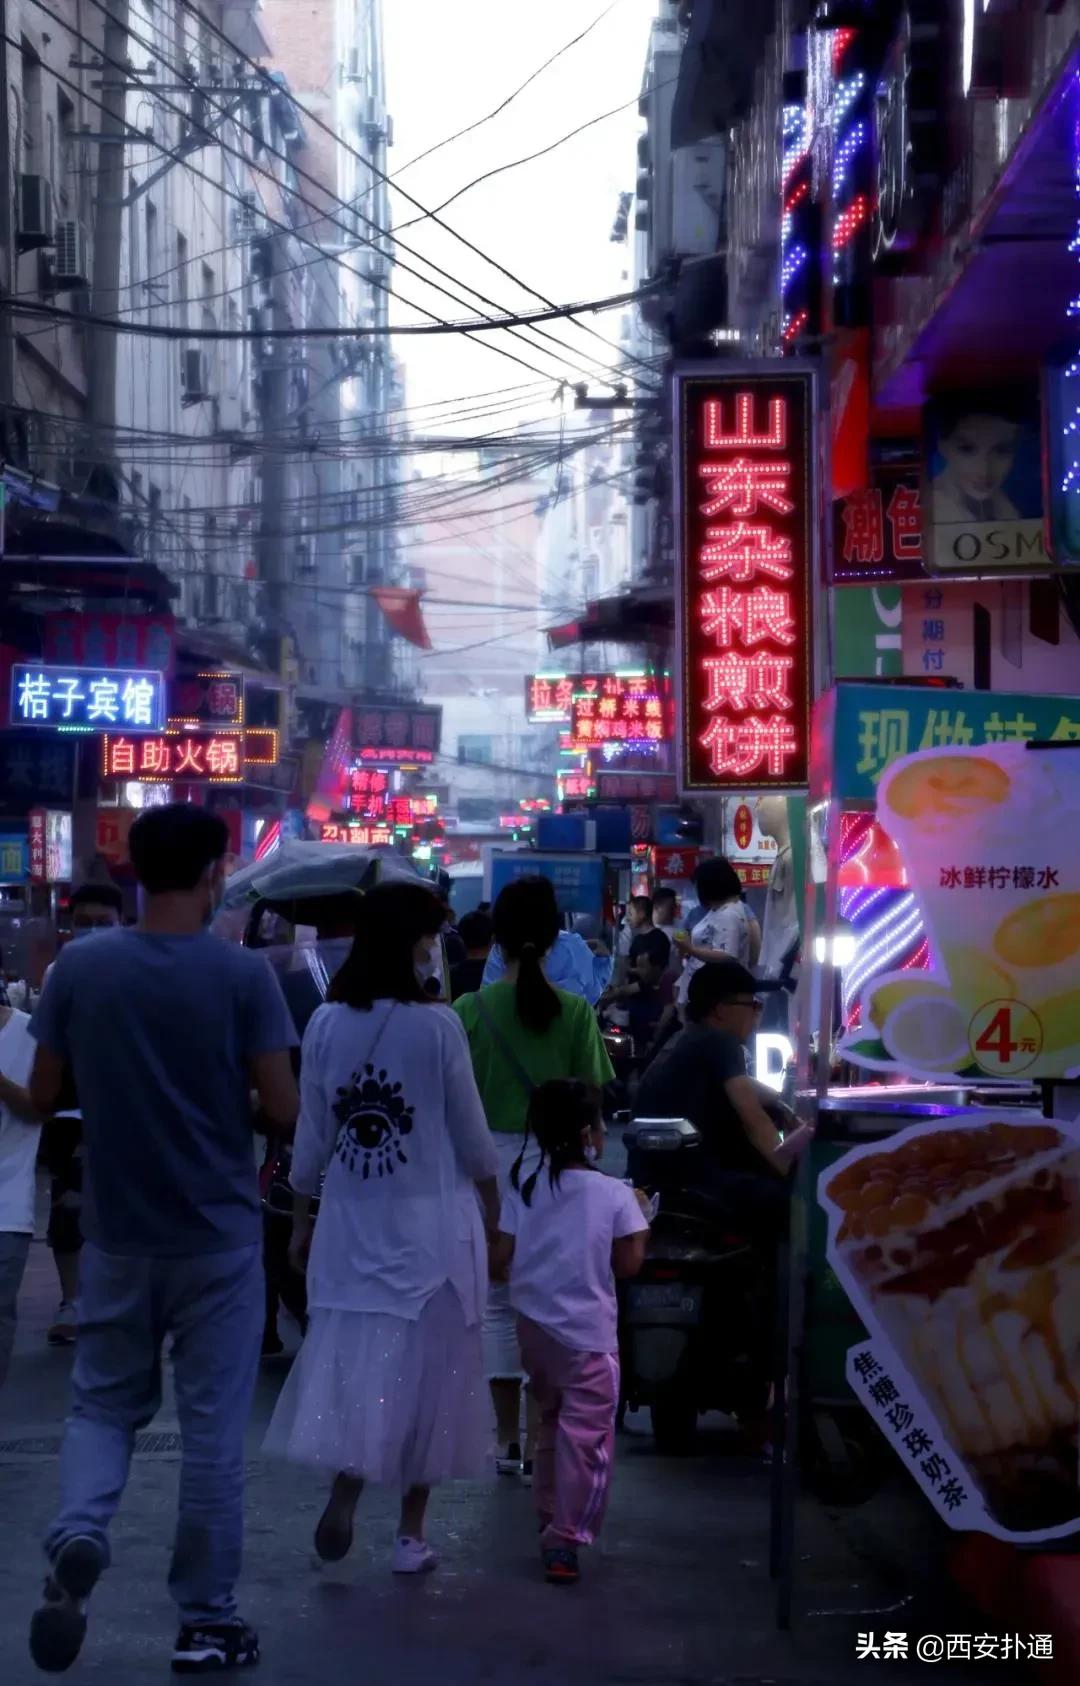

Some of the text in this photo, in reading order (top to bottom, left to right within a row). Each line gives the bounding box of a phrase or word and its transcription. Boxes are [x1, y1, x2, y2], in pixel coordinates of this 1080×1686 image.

[699, 393, 797, 776] 山东杂粮煎饼
[922, 588, 945, 671] 分期付
[18, 673, 154, 725] 桔子宾馆
[576, 698, 662, 718] 过桥米线
[575, 719, 663, 738] 黄焖鸡米饭
[111, 737, 239, 774] 自助火锅
[939, 866, 1061, 889] 冰鲜柠檬水
[853, 1350, 969, 1511] 焦糖珍珠奶茶
